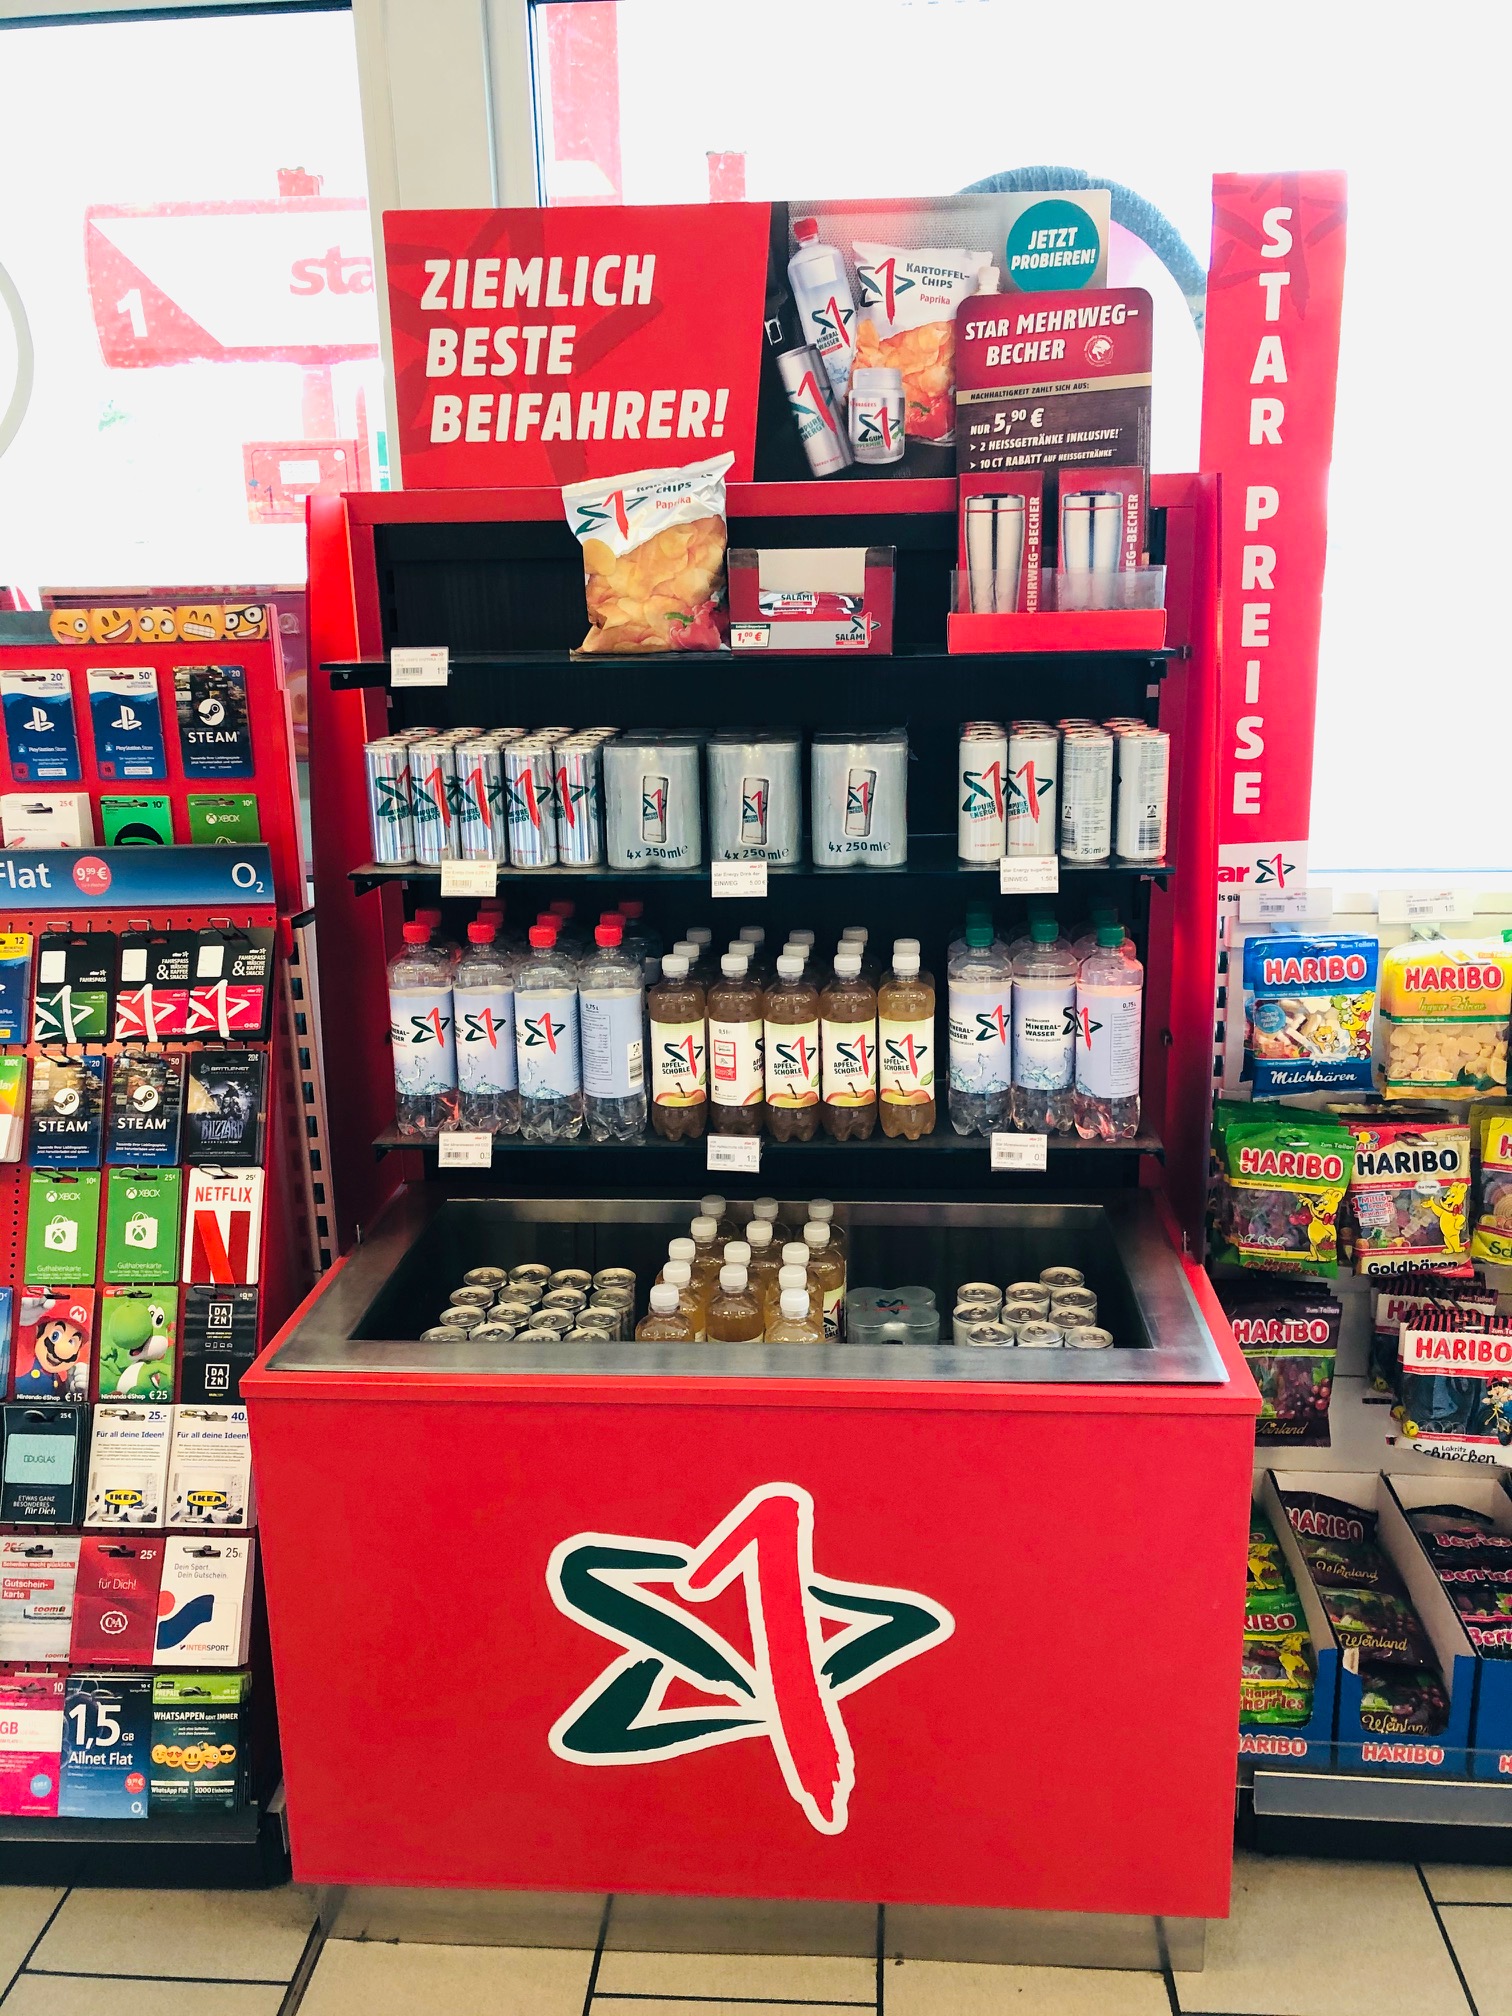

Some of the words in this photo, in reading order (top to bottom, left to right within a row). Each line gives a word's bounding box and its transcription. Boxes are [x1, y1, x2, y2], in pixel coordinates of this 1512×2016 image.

[1028, 227, 1078, 251] JETZT
[1011, 249, 1096, 271] PROBIEREN!
[289, 246, 375, 295] sta
[906, 262, 970, 280] KARTOFFEL-
[420, 254, 656, 311] ZIEMLICH
[922, 276, 953, 289] CHIPS
[920, 293, 951, 305] Paprika
[965, 319, 1010, 341] STAR
[1016, 304, 1139, 335] MEHRWEG-
[1249, 207, 1293, 445] STAR
[425, 325, 576, 378] BESTE
[985, 338, 1066, 367] BECHER
[970, 387, 1030, 401] NACHHALTIGKEIT
[1055, 384, 1071, 392] SICH
[1072, 382, 1090, 391] AUS:
[430, 388, 730, 443] BEIFAHRER!
[970, 424, 990, 435] NUR
[993, 408, 1027, 435] 5,90
[1030, 407, 1045, 428] €
[980, 441, 986, 451] 2
[988, 434, 1064, 451] HEISSGETRÄNKE
[980, 459, 991, 469] 10
[992, 458, 1002, 468] CT
[1006, 454, 1043, 467] RABATT
[1043, 454, 1058, 463] AUF
[1058, 449, 1113, 462] HEISSGETRÄNKE
[737, 632, 753, 643] 1,00
[755, 632, 762, 641] €
[835, 633, 866, 641] SALAMI
[1233, 486, 1279, 814] PREISE
[188, 731, 238, 743] STEAM
[217, 814, 240, 822] XBOX
[828, 841, 842, 853] 4x
[626, 848, 641, 860] 4x
[725, 850, 739, 860] 4x
[76, 867, 96, 882] 9,99
[97, 867, 107, 880] €
[1354, 940, 1376, 948] Teilen
[156, 964, 169, 980] &
[232, 960, 245, 976] &
[1264, 955, 1367, 984] HARIBO
[1405, 965, 1504, 991] HARIBO
[1025, 1022, 1061, 1030] MINERAL-
[662, 1067, 691, 1075] SCHORLE
[774, 1067, 802, 1075] SCHORLE
[834, 1066, 862, 1075] SCHORLE
[884, 1063, 910, 1071] SCHORLE
[1270, 1070, 1357, 1086] Milchbären
[38, 1120, 89, 1133] STEAM
[117, 1118, 167, 1130] STEAM
[201, 1120, 243, 1140] BLIZZARD
[1239, 1148, 1343, 1180] HARIBO
[1356, 1149, 1458, 1176] HARIBO
[58, 1192, 81, 1201] XBOX
[138, 1189, 161, 1197] XBOX
[195, 1186, 253, 1204] NETFLIX
[37, 1265, 82, 1273] Guthabenkarte
[117, 1262, 162, 1270] Guthabenkarte
[214, 1307, 228, 1315] DA
[214, 1316, 227, 1325] ZN
[1233, 1318, 1330, 1343] HARIBO
[1416, 1336, 1512, 1363] HARIBO
[211, 1368, 224, 1376] DA
[210, 1377, 224, 1385] ZN
[65, 1392, 72, 1402] €
[73, 1392, 82, 1402] 15
[149, 1391, 156, 1400] €
[156, 1391, 168, 1400] 25
[24, 1506, 38, 1515] für
[38, 1507, 56, 1515] Dich
[1286, 1507, 1364, 1543] HARIBO
[4, 1580, 48, 1589] Gutschein-
[98, 1578, 111, 1590] für
[112, 1578, 137, 1590] Dich!
[3, 1590, 25, 1598] karte
[1338, 1633, 1408, 1650] Weinland
[1245, 1688, 1283, 1699] Happy
[153, 1711, 205, 1720] WHATSAPPEN
[68, 1701, 121, 1750] 1,5
[122, 1733, 135, 1741] GB
[1239, 1737, 1307, 1757] ARIBO
[1362, 1742, 1444, 1765] HARIBO
[69, 1752, 106, 1765] Allnet
[109, 1752, 133, 1765] Flat
